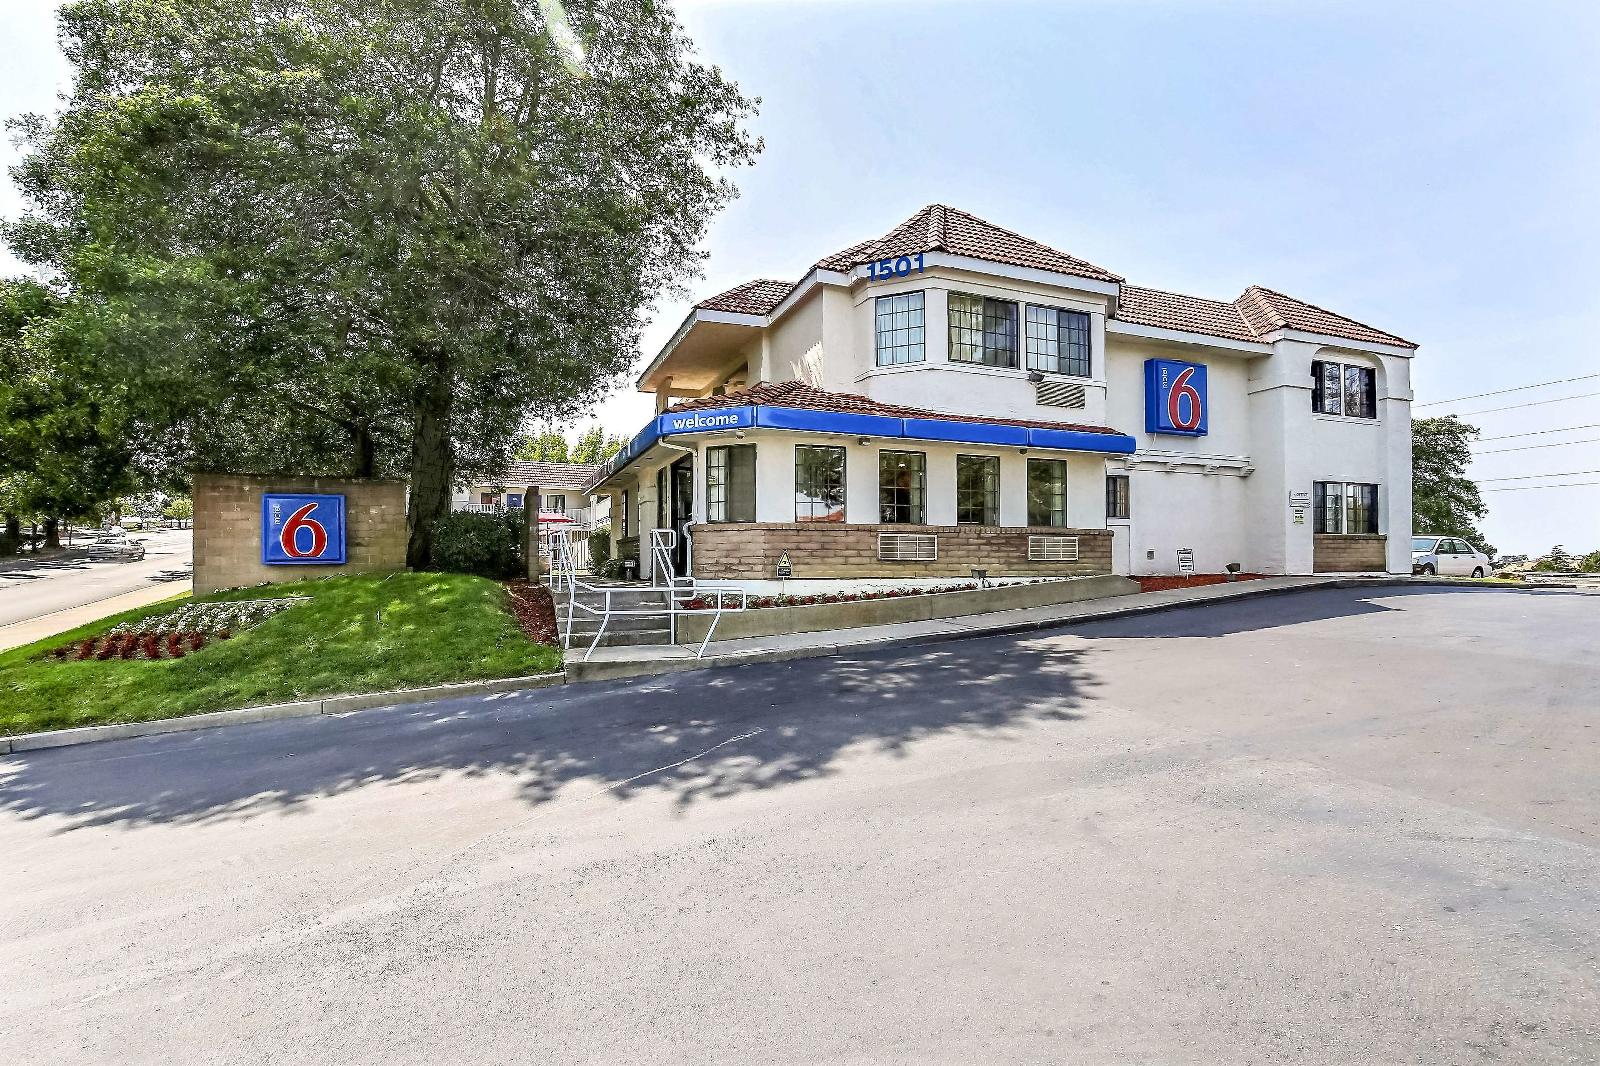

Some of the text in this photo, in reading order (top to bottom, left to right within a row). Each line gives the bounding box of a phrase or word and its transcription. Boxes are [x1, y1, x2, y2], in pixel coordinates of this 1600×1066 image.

[867, 252, 924, 282] 1501
[1167, 367, 1202, 430] 6
[672, 413, 739, 429] welcome
[280, 502, 328, 559] 6
